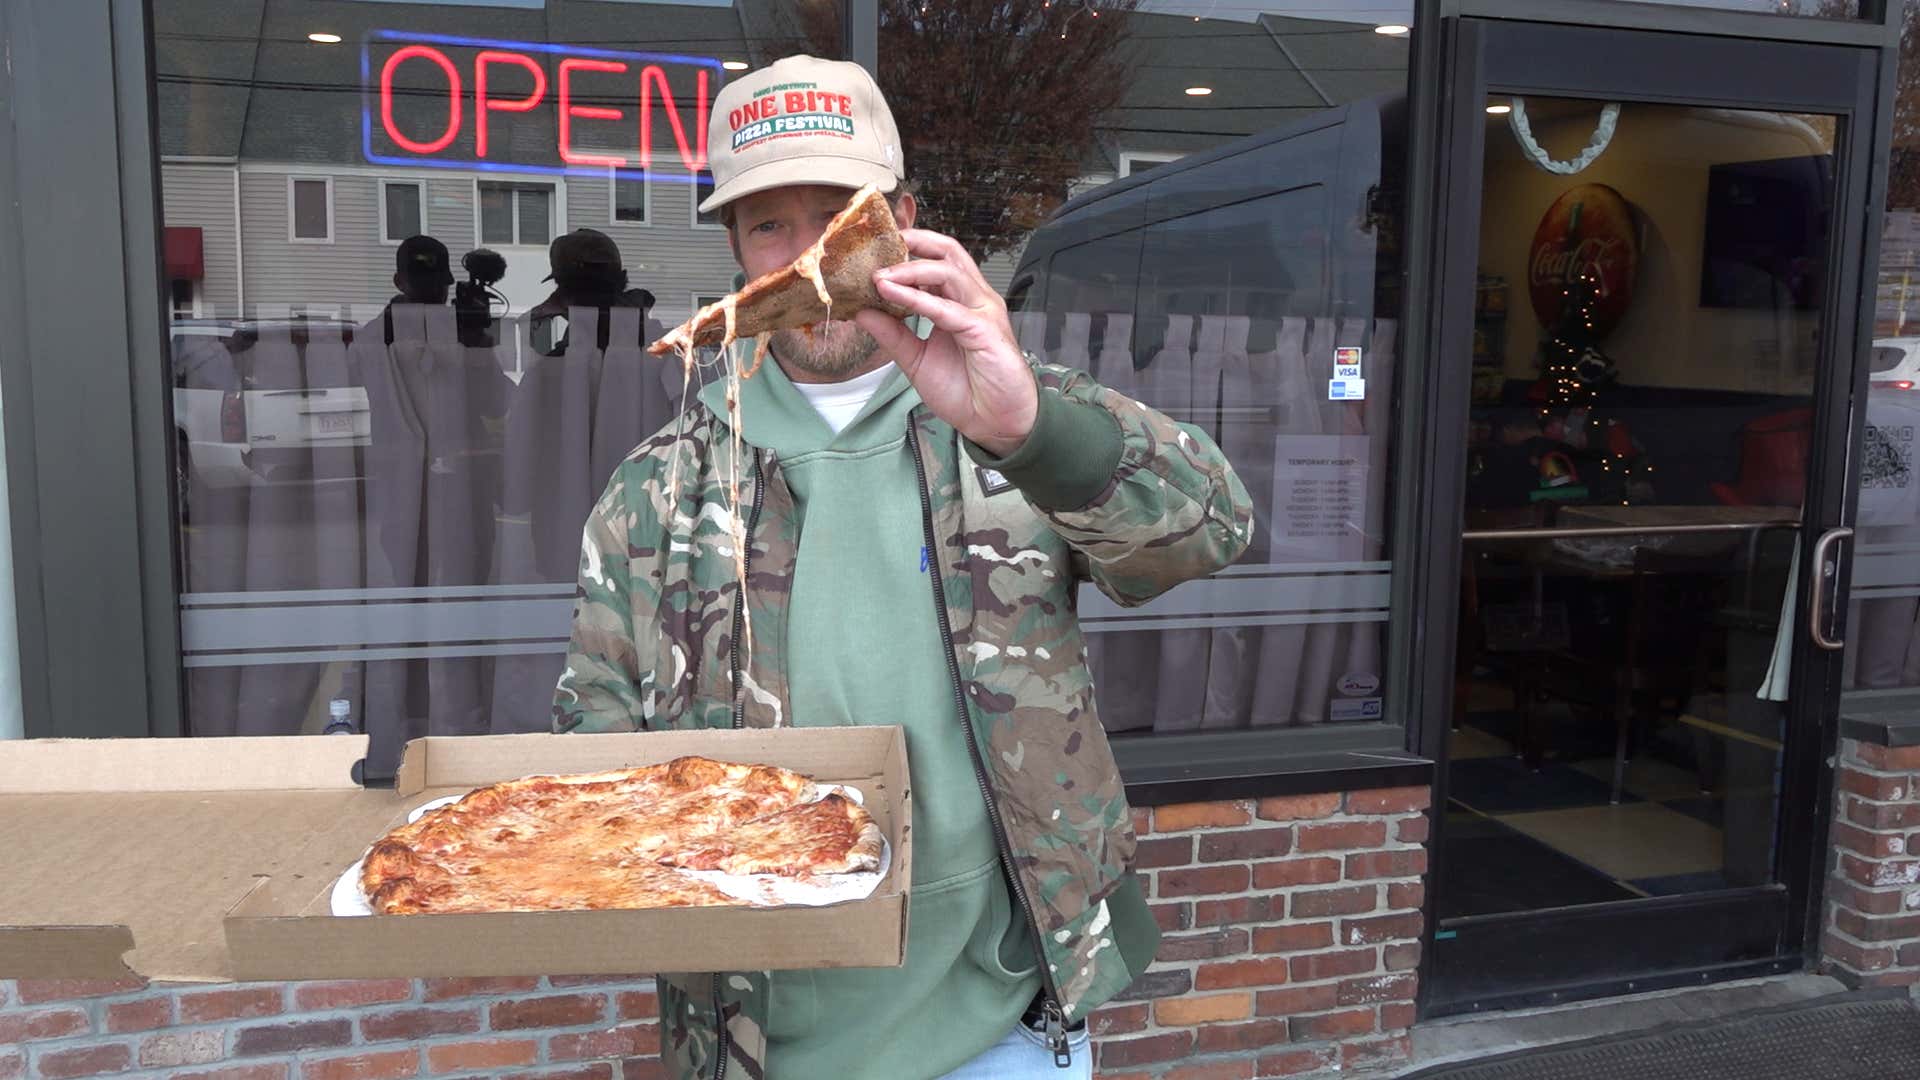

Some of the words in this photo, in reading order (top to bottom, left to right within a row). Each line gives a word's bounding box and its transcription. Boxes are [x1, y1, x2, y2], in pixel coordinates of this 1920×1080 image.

[381, 46, 708, 171] OPEN
[729, 95, 778, 131] ONE
[784, 91, 852, 116] BITE
[735, 122, 772, 146] PIZZA
[775, 115, 851, 132] FESTIVAL
[1338, 368, 1358, 376] VISA
